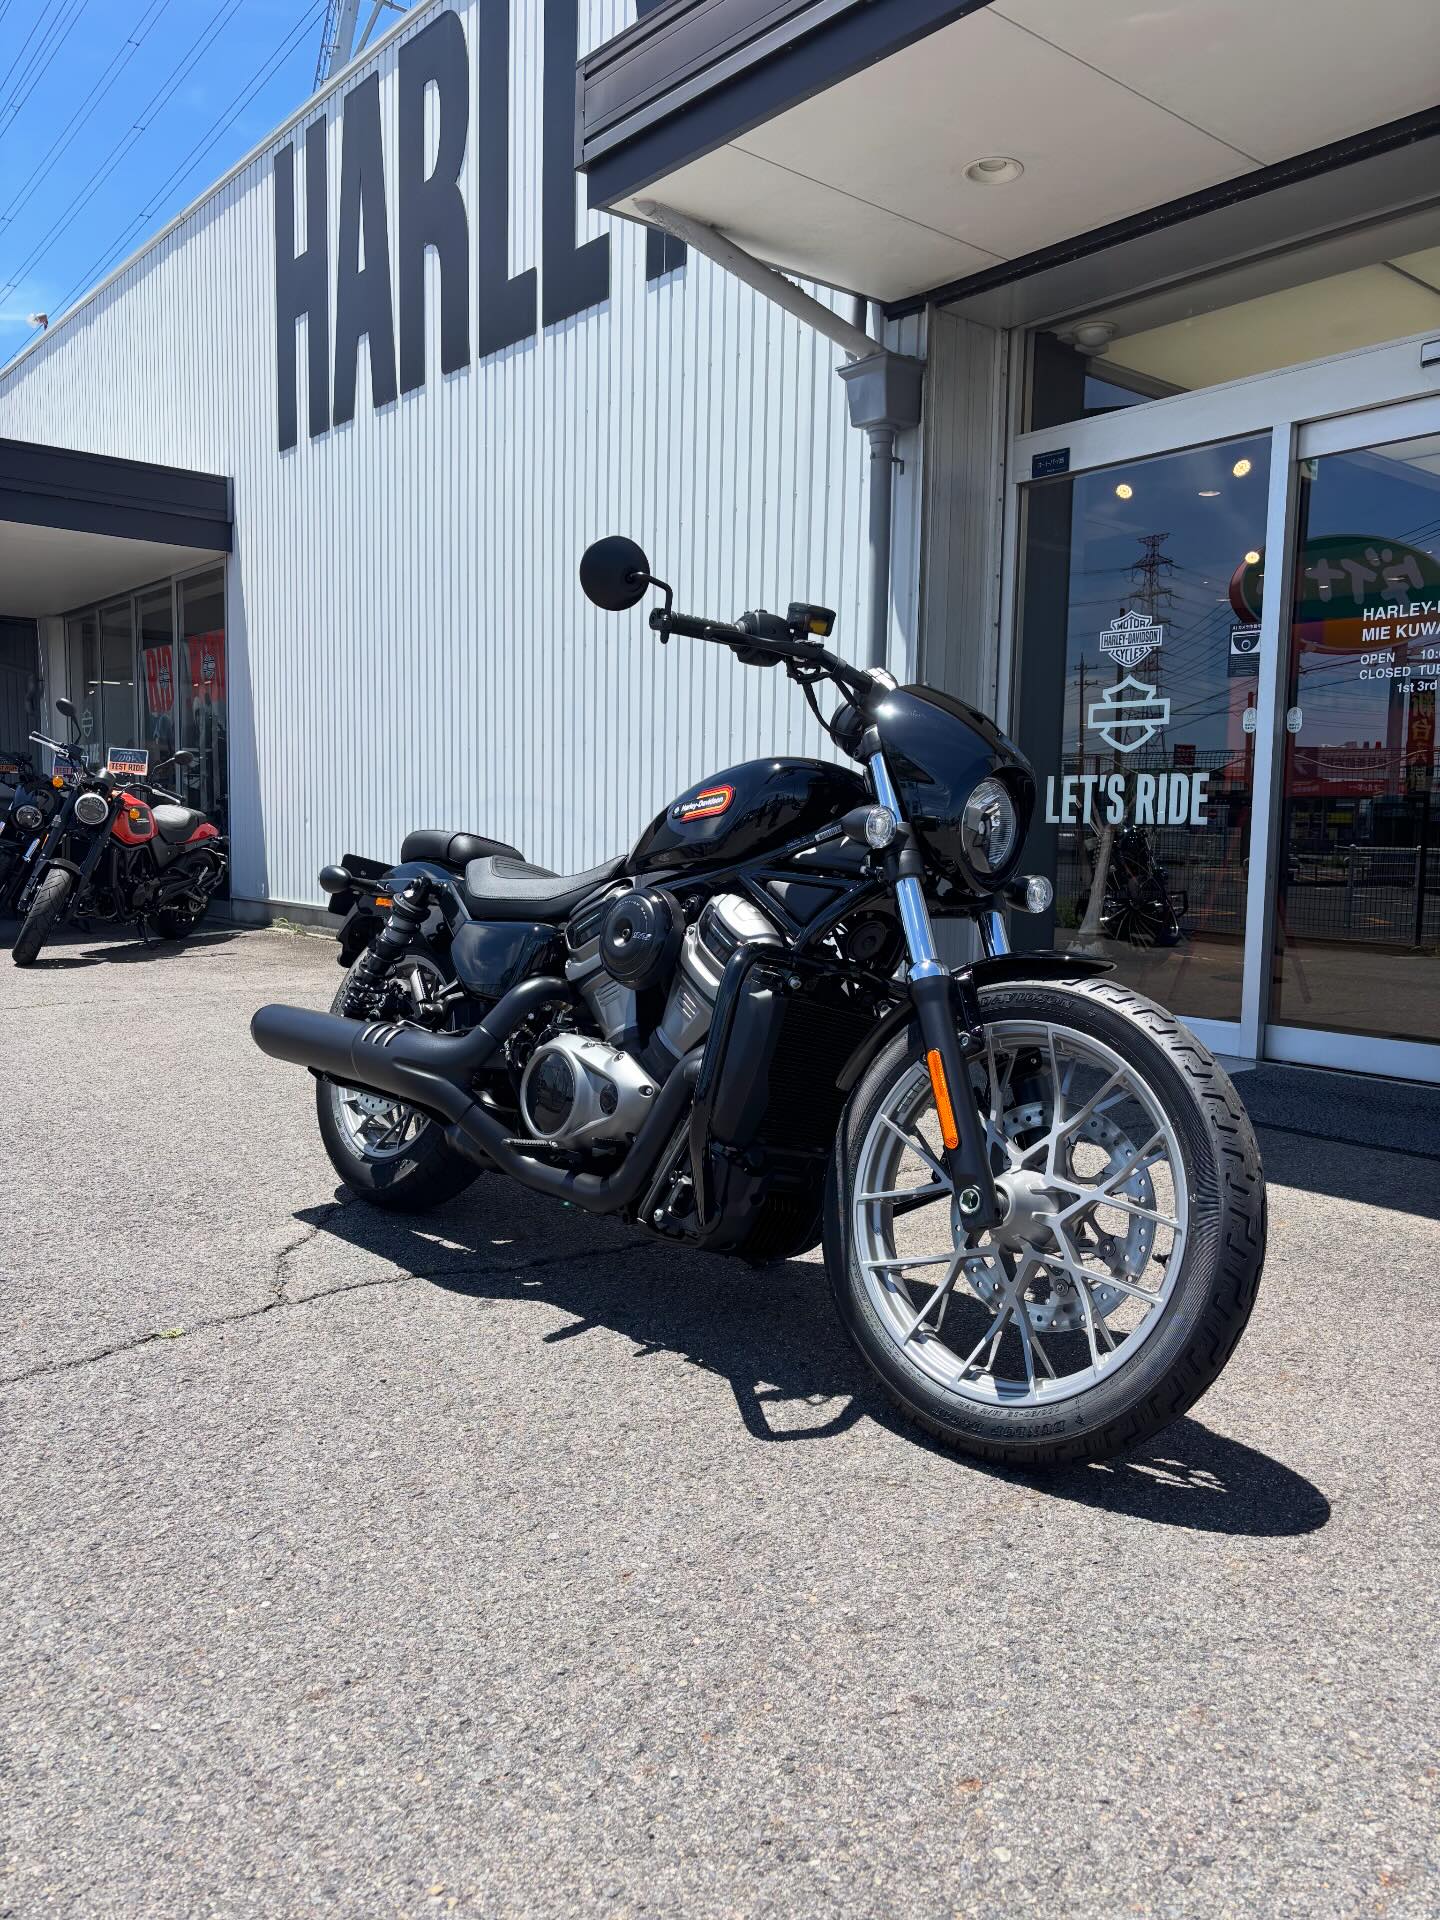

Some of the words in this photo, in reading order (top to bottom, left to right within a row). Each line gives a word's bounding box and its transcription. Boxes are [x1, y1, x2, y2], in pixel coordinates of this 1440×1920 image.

[1363, 601, 1440, 621] HARLEY-
[1116, 619, 1146, 631] MOTOR
[1103, 630, 1159, 647] HARLEY-DAVIDSON
[1362, 626, 1391, 641] MIE
[1115, 647, 1145, 663] CYCLES
[1360, 652, 1395, 665] OPEN
[1420, 648, 1440, 660] 10:
[1360, 666, 1411, 680] CLOSED
[1397, 682, 1414, 693] 1st
[1417, 680, 1437, 691] 3rd
[112, 762, 127, 771] TEST
[128, 763, 145, 772] RIDE
[681, 796, 723, 811] Harley-Davidson
[1045, 773, 1126, 825] LET'S
[1135, 772, 1210, 825] RIDE
